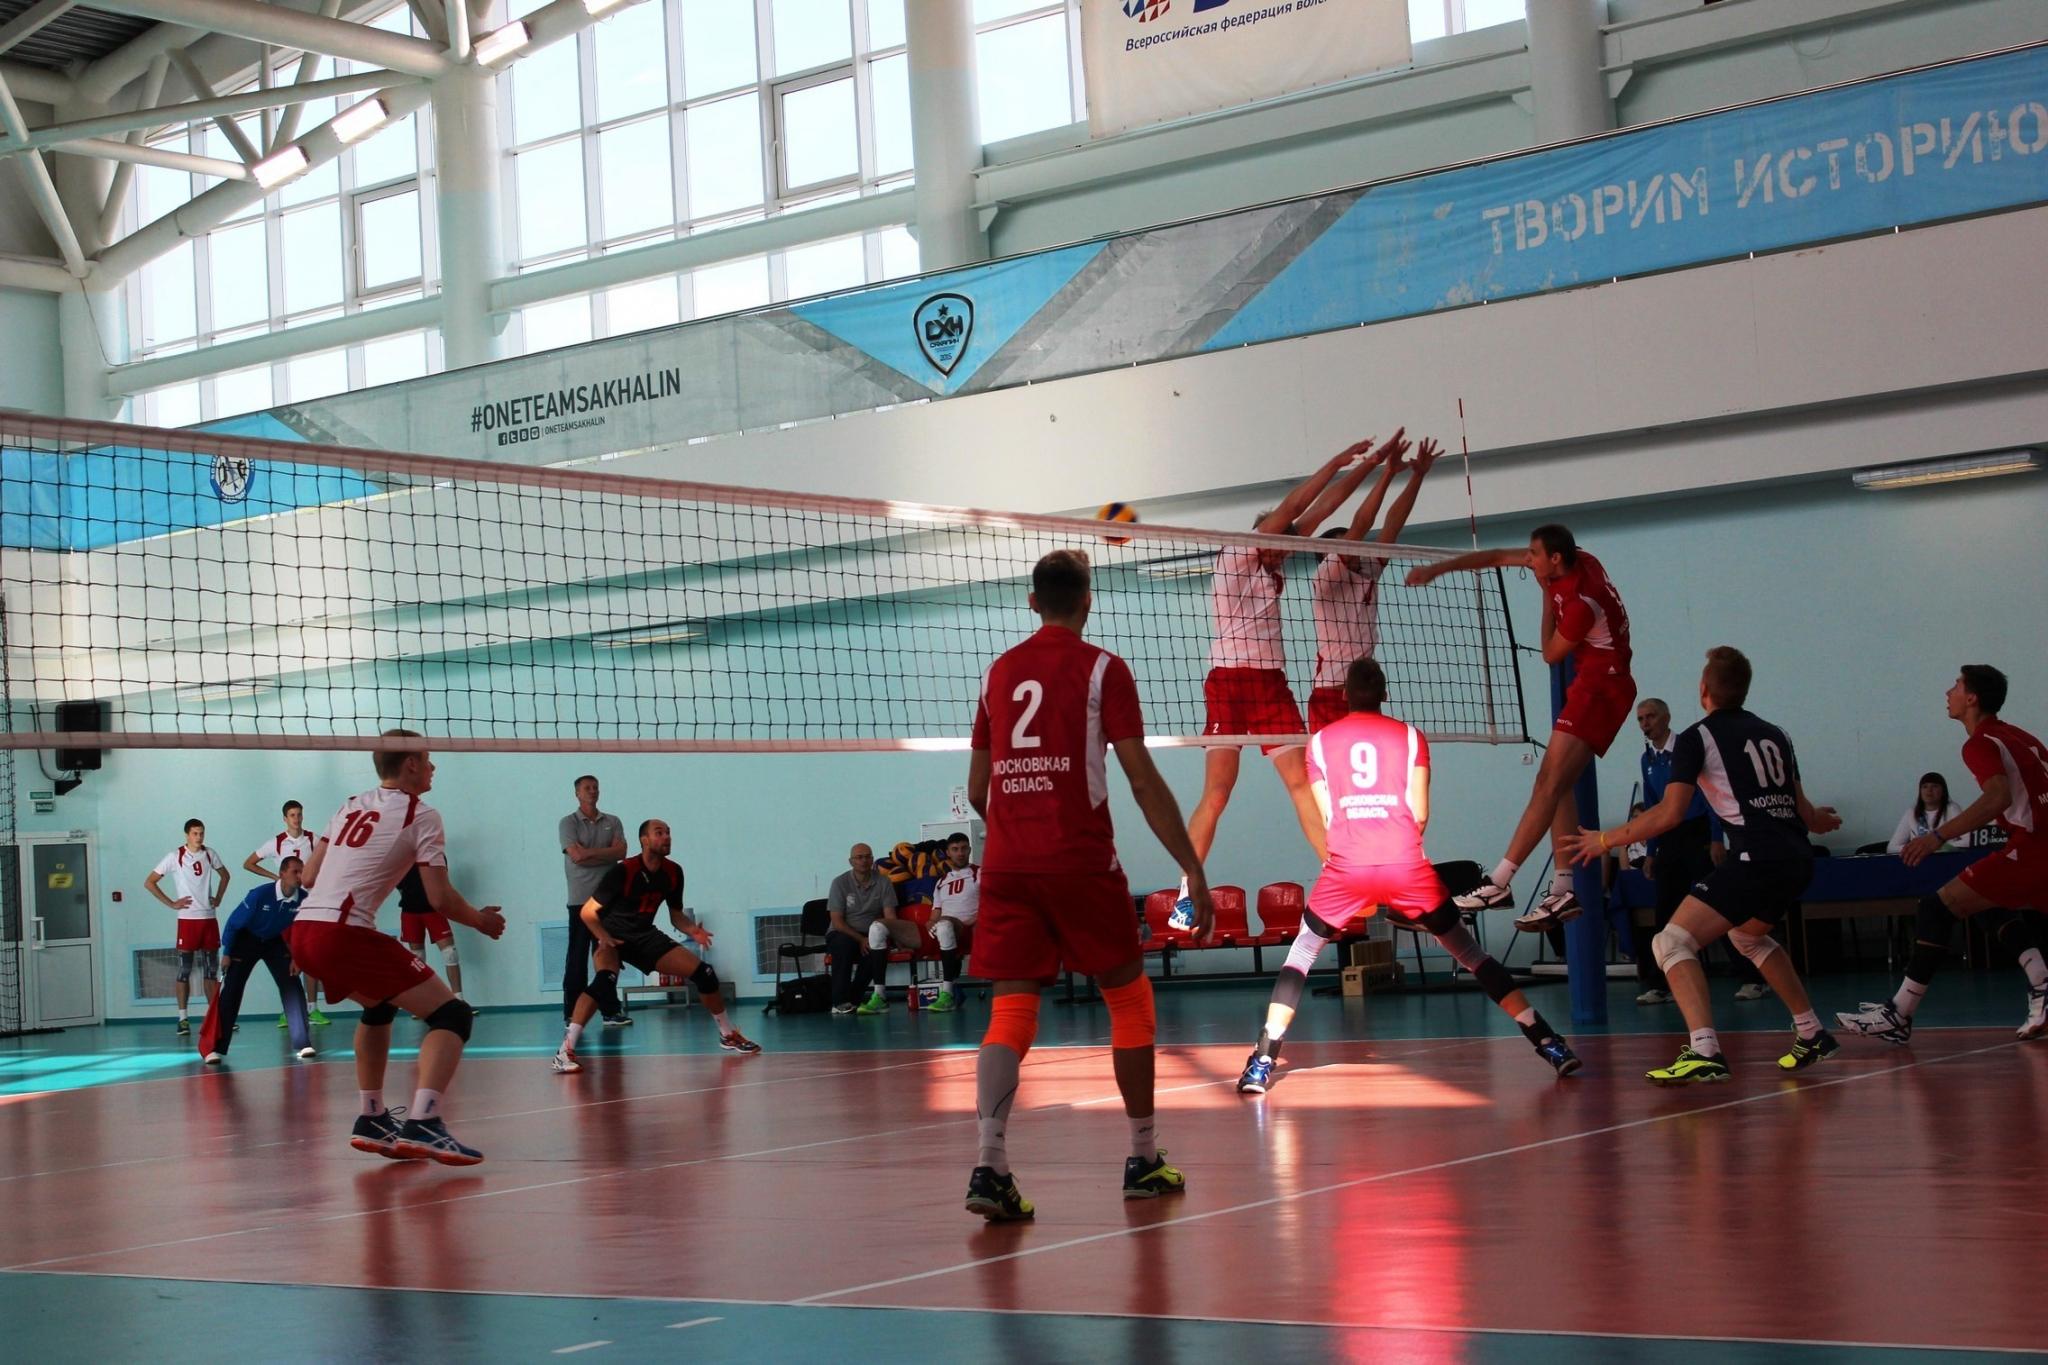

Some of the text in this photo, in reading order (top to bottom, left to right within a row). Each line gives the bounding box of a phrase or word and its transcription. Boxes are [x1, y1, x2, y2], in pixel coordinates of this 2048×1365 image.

[1126, 21, 1217, 51] Всероссийская
[1220, 4, 1292, 32] федерация
[1482, 102, 2048, 255] ТВОРИМ ИСТОРИЮ
[471, 368, 681, 432] #ONETEAMSAKHALIN
[545, 416, 605, 435] ONETEAMSAKHALIN
[1011, 679, 1043, 748] 2
[1213, 723, 1219, 733] 2
[1350, 741, 1378, 789] 9
[1744, 739, 1786, 788] 10
[1002, 776, 1054, 793] ОБЛАСТЬ
[334, 809, 380, 848] 16
[1972, 828, 1989, 847] 18
[193, 860, 203, 876] 9
[948, 879, 965, 896] 10
[410, 957, 425, 972] 16
